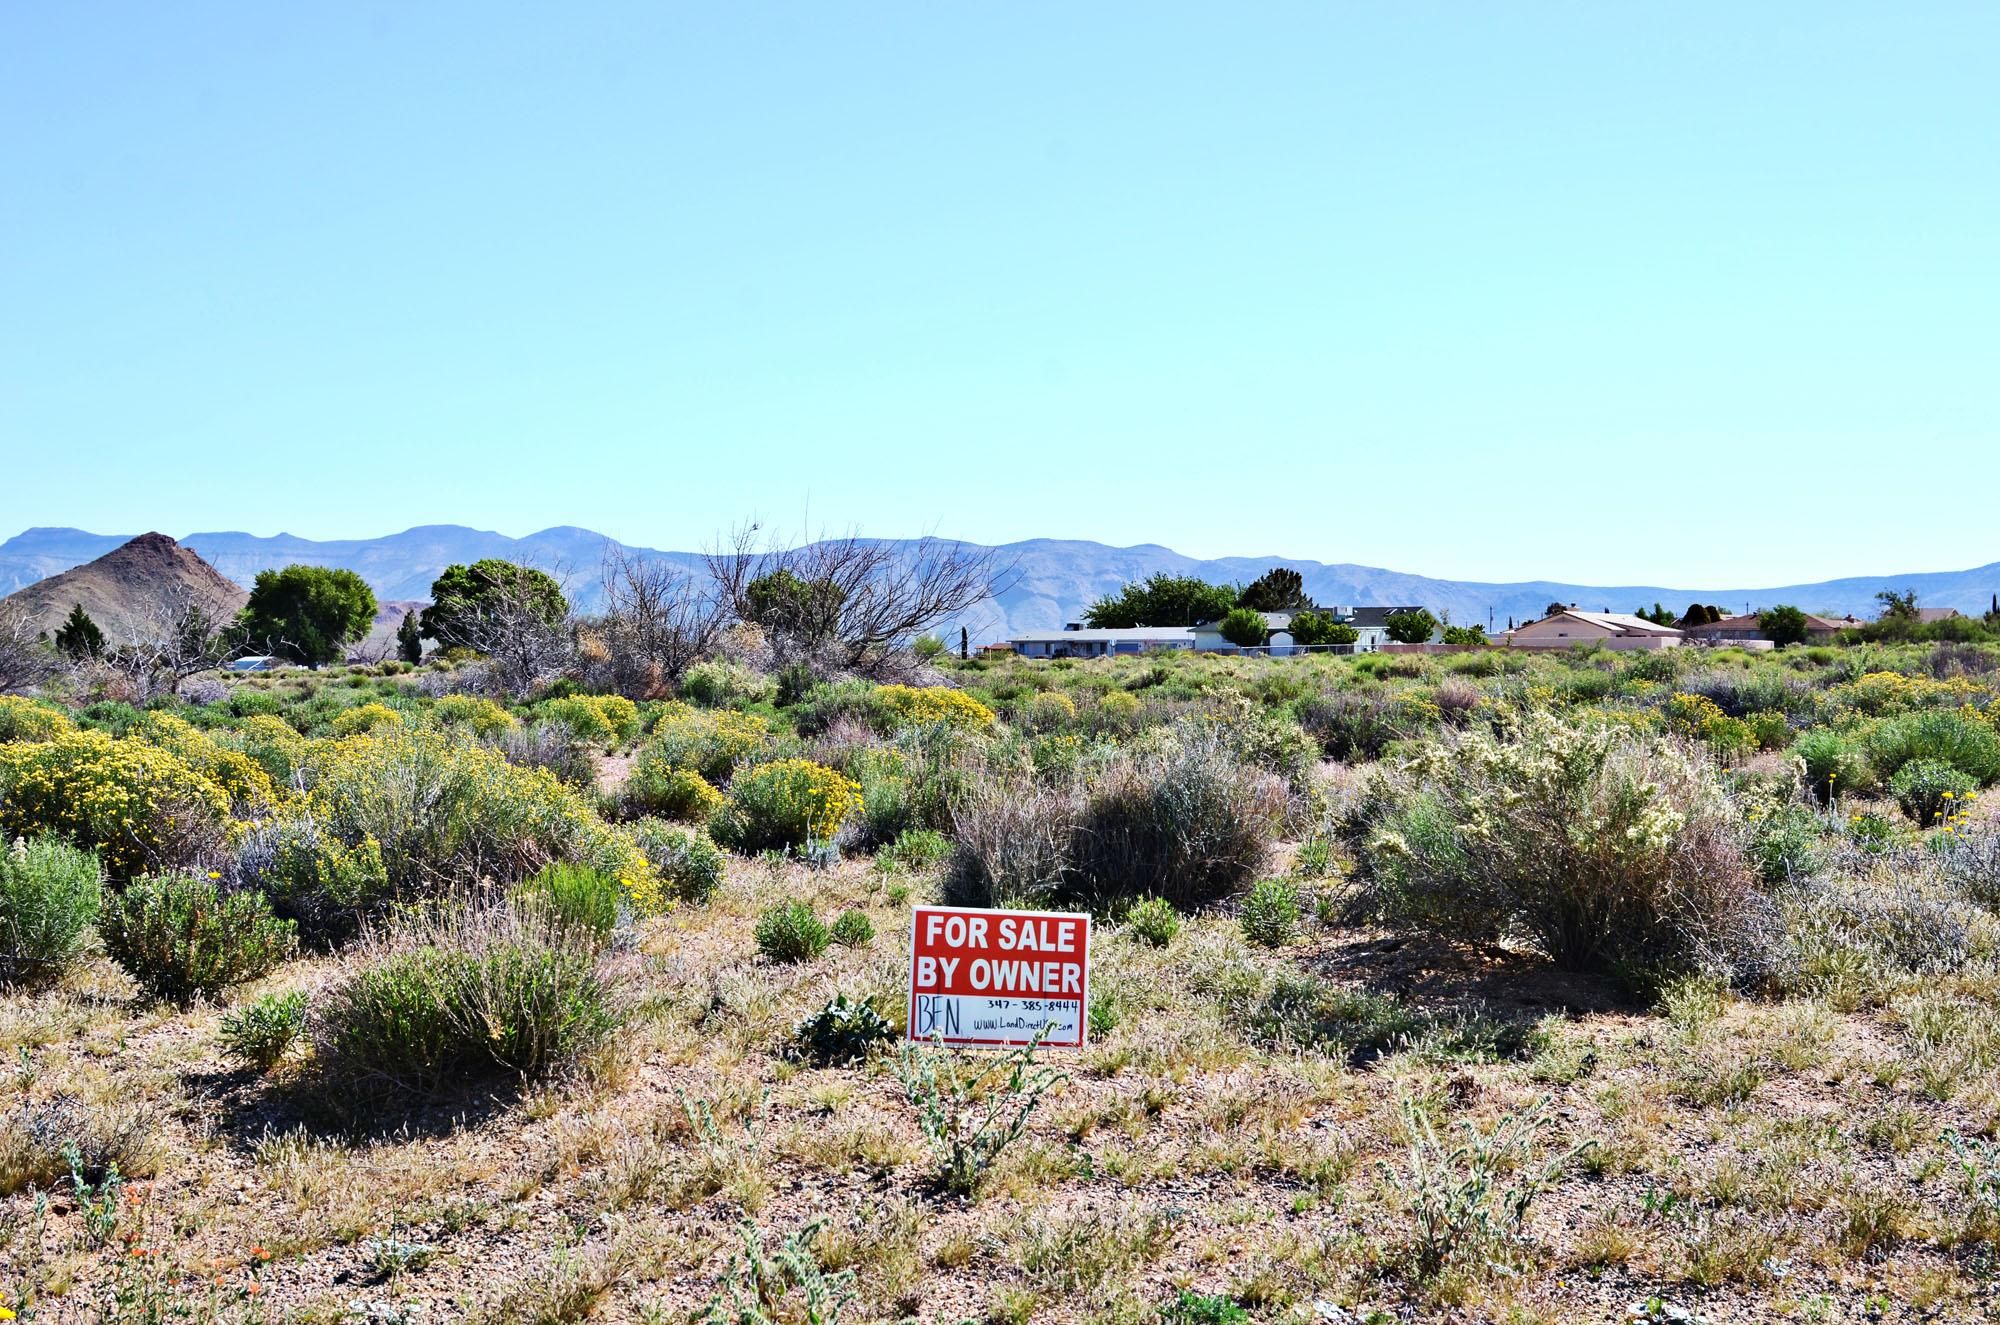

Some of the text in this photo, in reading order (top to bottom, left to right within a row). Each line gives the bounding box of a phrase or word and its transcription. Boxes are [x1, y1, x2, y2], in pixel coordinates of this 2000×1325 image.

[926, 915, 1075, 952] FOR SALE
[917, 956, 1081, 993] BY OWNER
